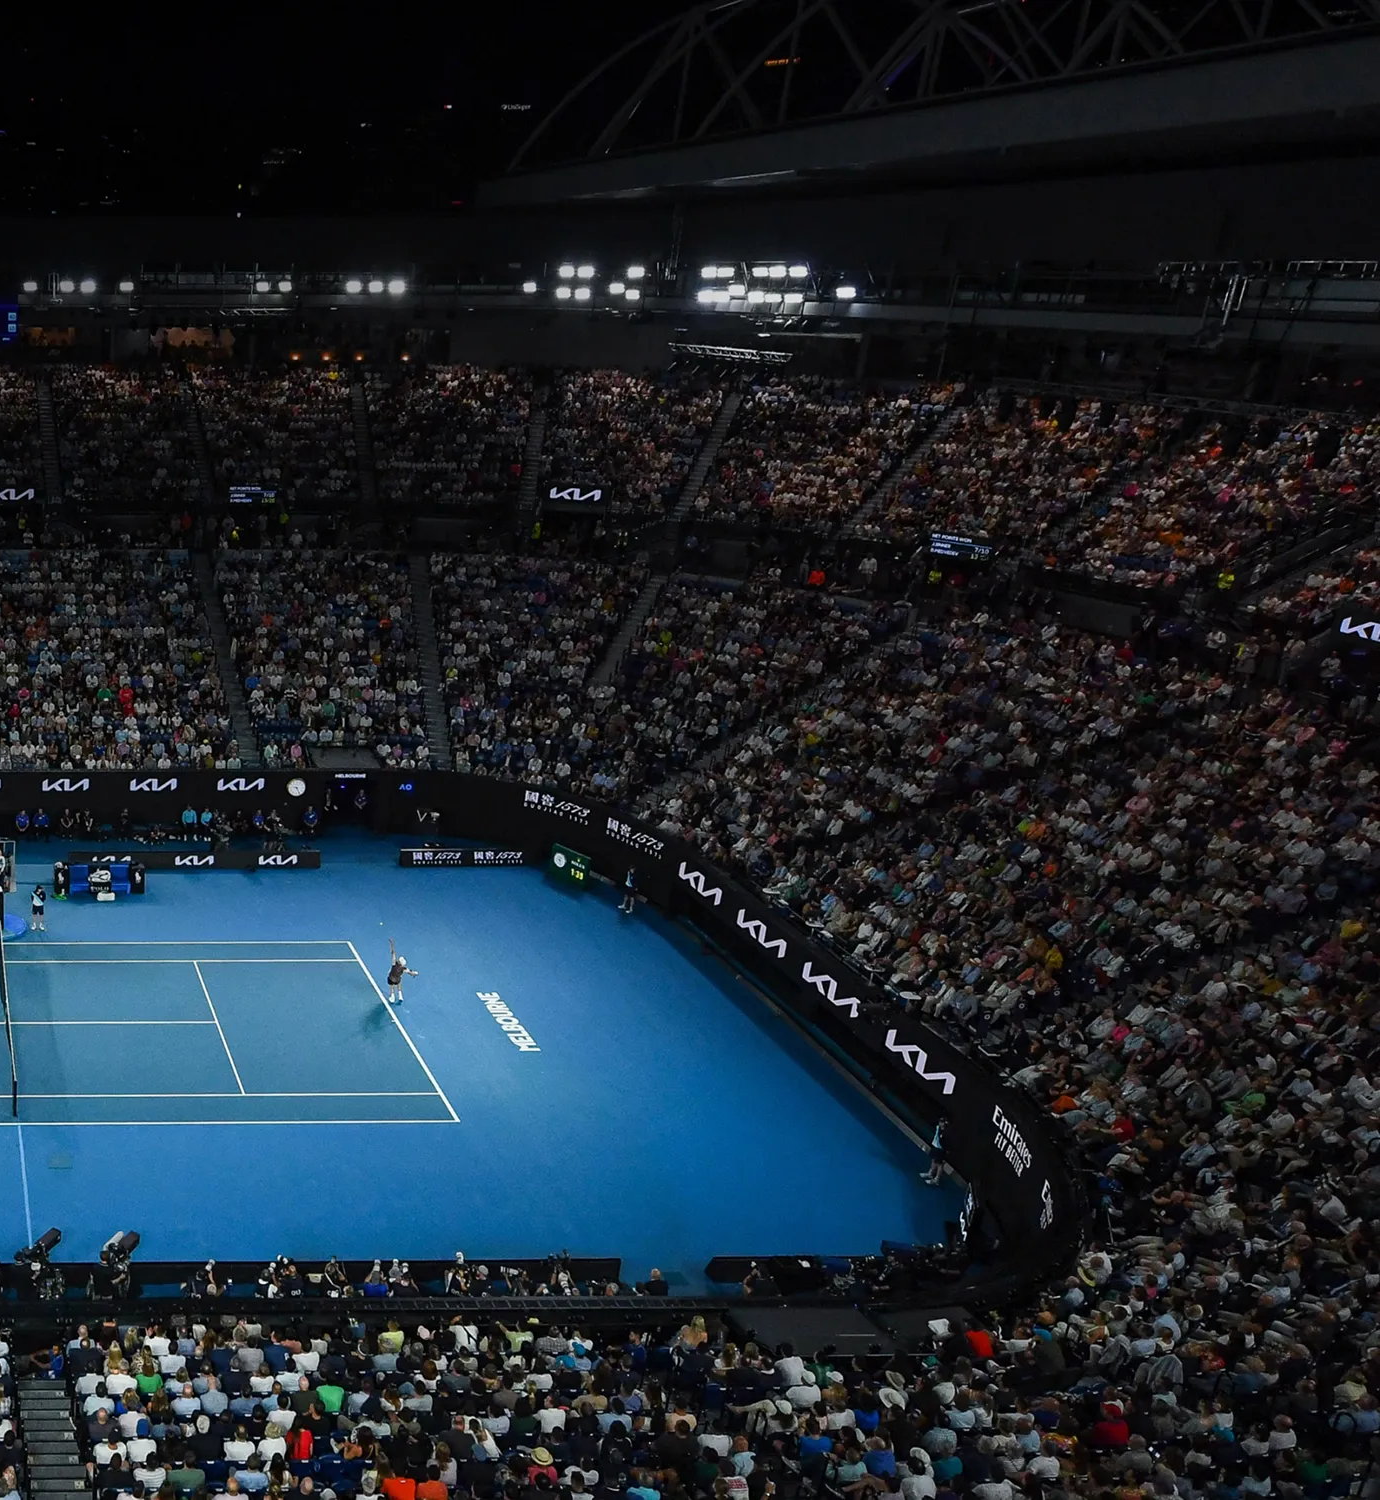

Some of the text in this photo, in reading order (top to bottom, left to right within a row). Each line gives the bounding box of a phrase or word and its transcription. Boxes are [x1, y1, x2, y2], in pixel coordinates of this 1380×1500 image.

[549, 486, 602, 502] KIA
[42, 778, 90, 792] KIA
[129, 778, 178, 792] KIA
[217, 777, 265, 791] KIA
[174, 854, 214, 866] KIA
[258, 854, 298, 866] KIA
[678, 861, 723, 906] KIA
[736, 908, 787, 958] KIA
[802, 961, 861, 1018] KIA
[476, 991, 541, 1052] MELBOURNE
[885, 1028, 956, 1095] KIA
[992, 1104, 1032, 1168] Emirates
[994, 1131, 1024, 1178] FLY BETTER
